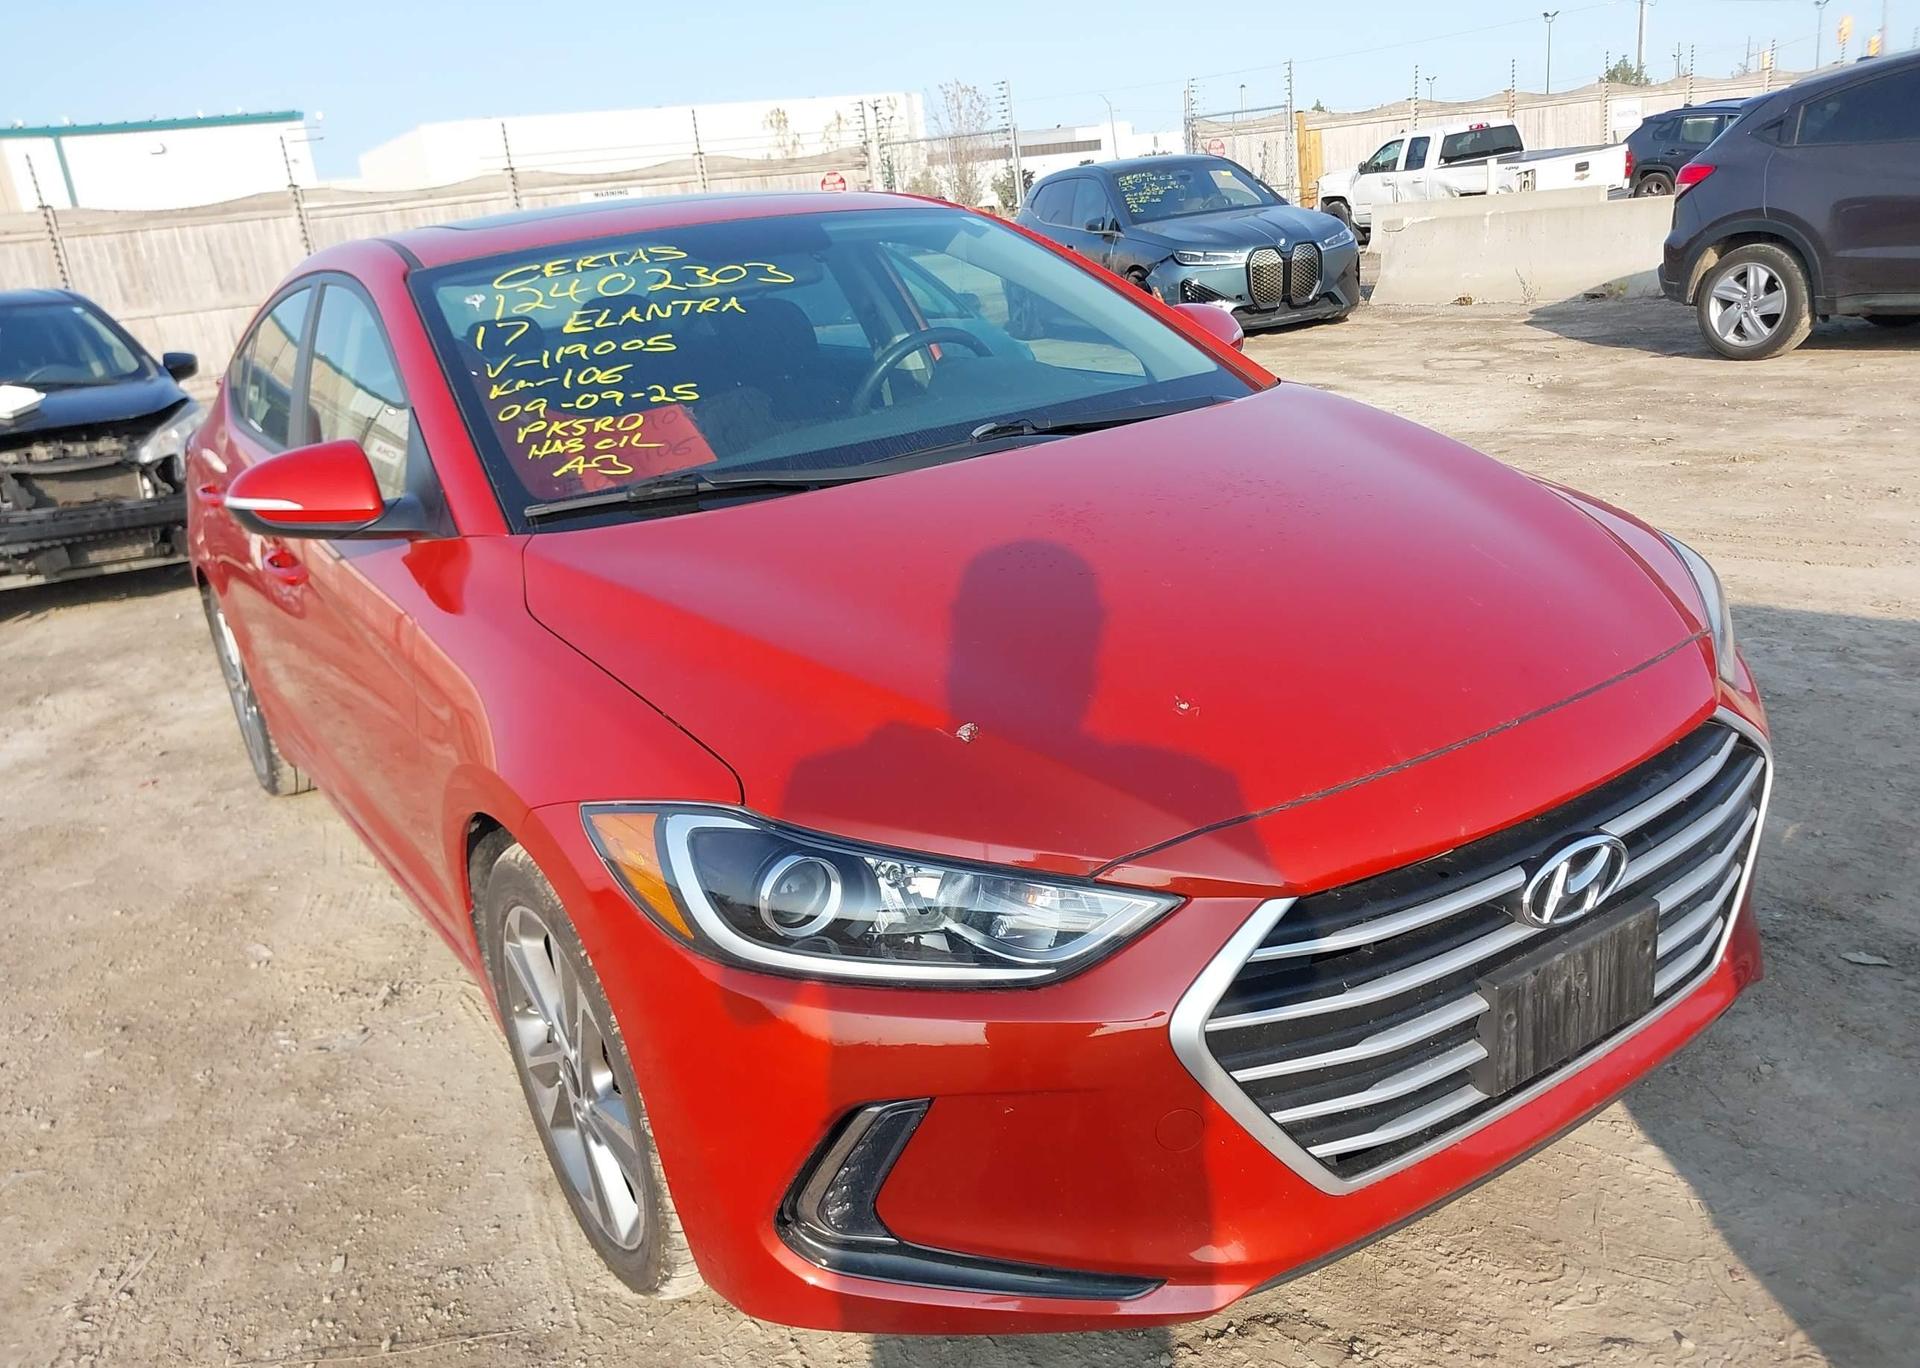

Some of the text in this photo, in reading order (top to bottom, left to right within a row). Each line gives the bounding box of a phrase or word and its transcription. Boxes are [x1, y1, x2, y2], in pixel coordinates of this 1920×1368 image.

[492, 246, 688, 289] CERTAS
[475, 296, 748, 351] 17 ELANTRA
[527, 432, 665, 460] HAS OIL
